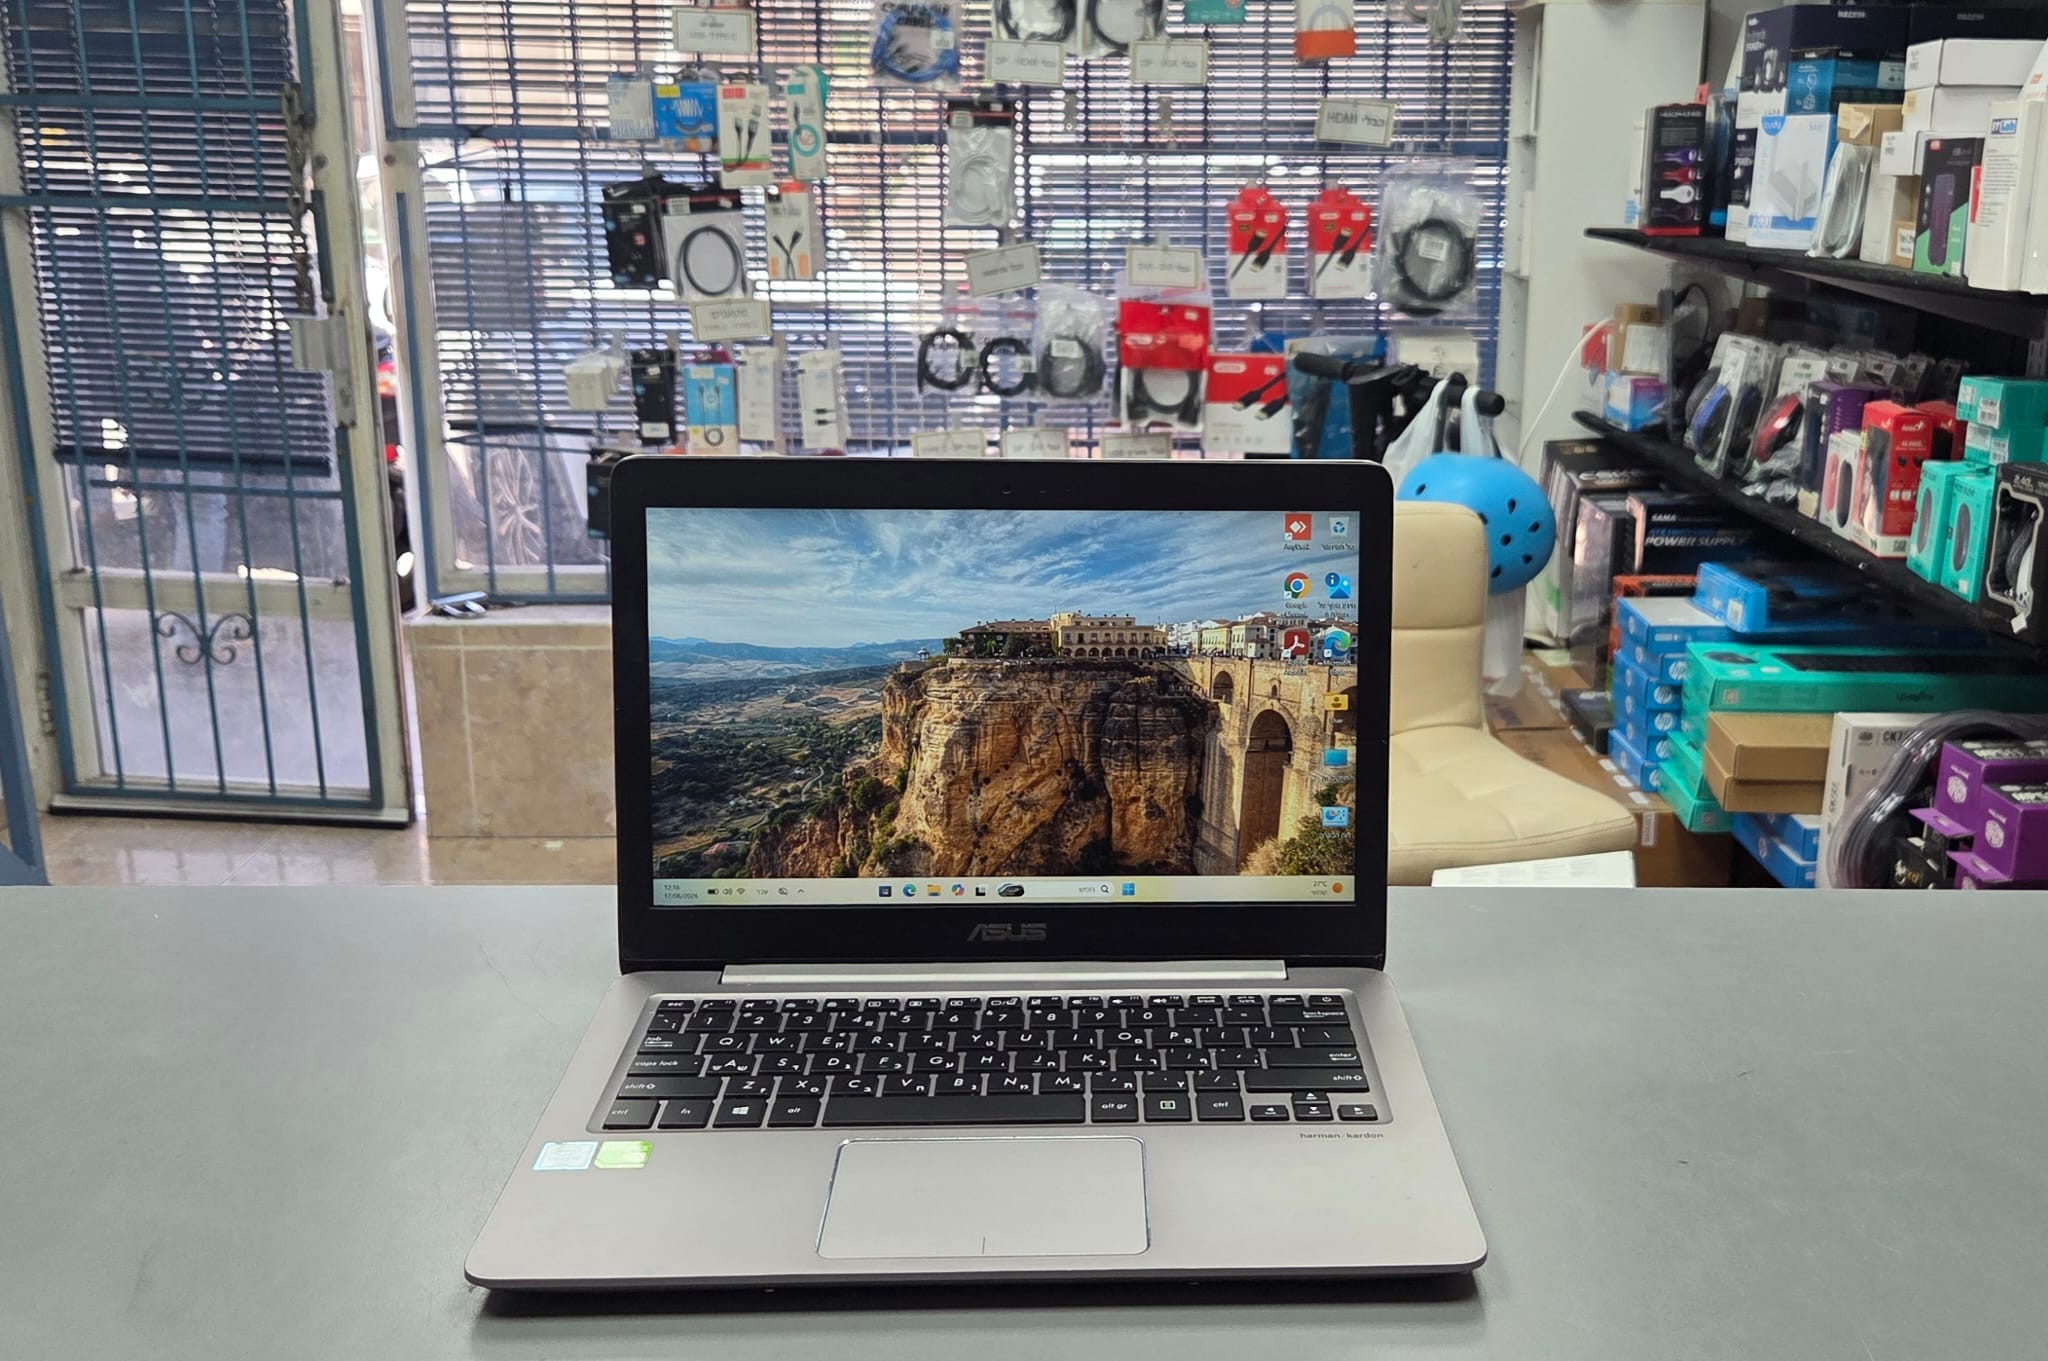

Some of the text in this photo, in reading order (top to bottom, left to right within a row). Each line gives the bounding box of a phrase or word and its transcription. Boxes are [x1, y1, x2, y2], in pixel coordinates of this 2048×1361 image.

[1327, 112, 1358, 125] HDMI
[1645, 536, 1746, 547] POWER SUPPLY
[1654, 713, 1674, 731] hp
[967, 923, 1048, 942] ASUS
[803, 1016, 813, 1024] 3
[901, 1015, 910, 1023] 5
[1047, 1013, 1056, 1021] 8
[1096, 1012, 1104, 1020] 9
[872, 1036, 881, 1044] R
[923, 1035, 931, 1043] T
[1118, 1032, 1132, 1040] O
[778, 1058, 788, 1066] S
[1083, 1054, 1093, 1062] K
[743, 1081, 755, 1089] Z
[796, 1080, 808, 1088] X
[849, 1080, 861, 1088] C
